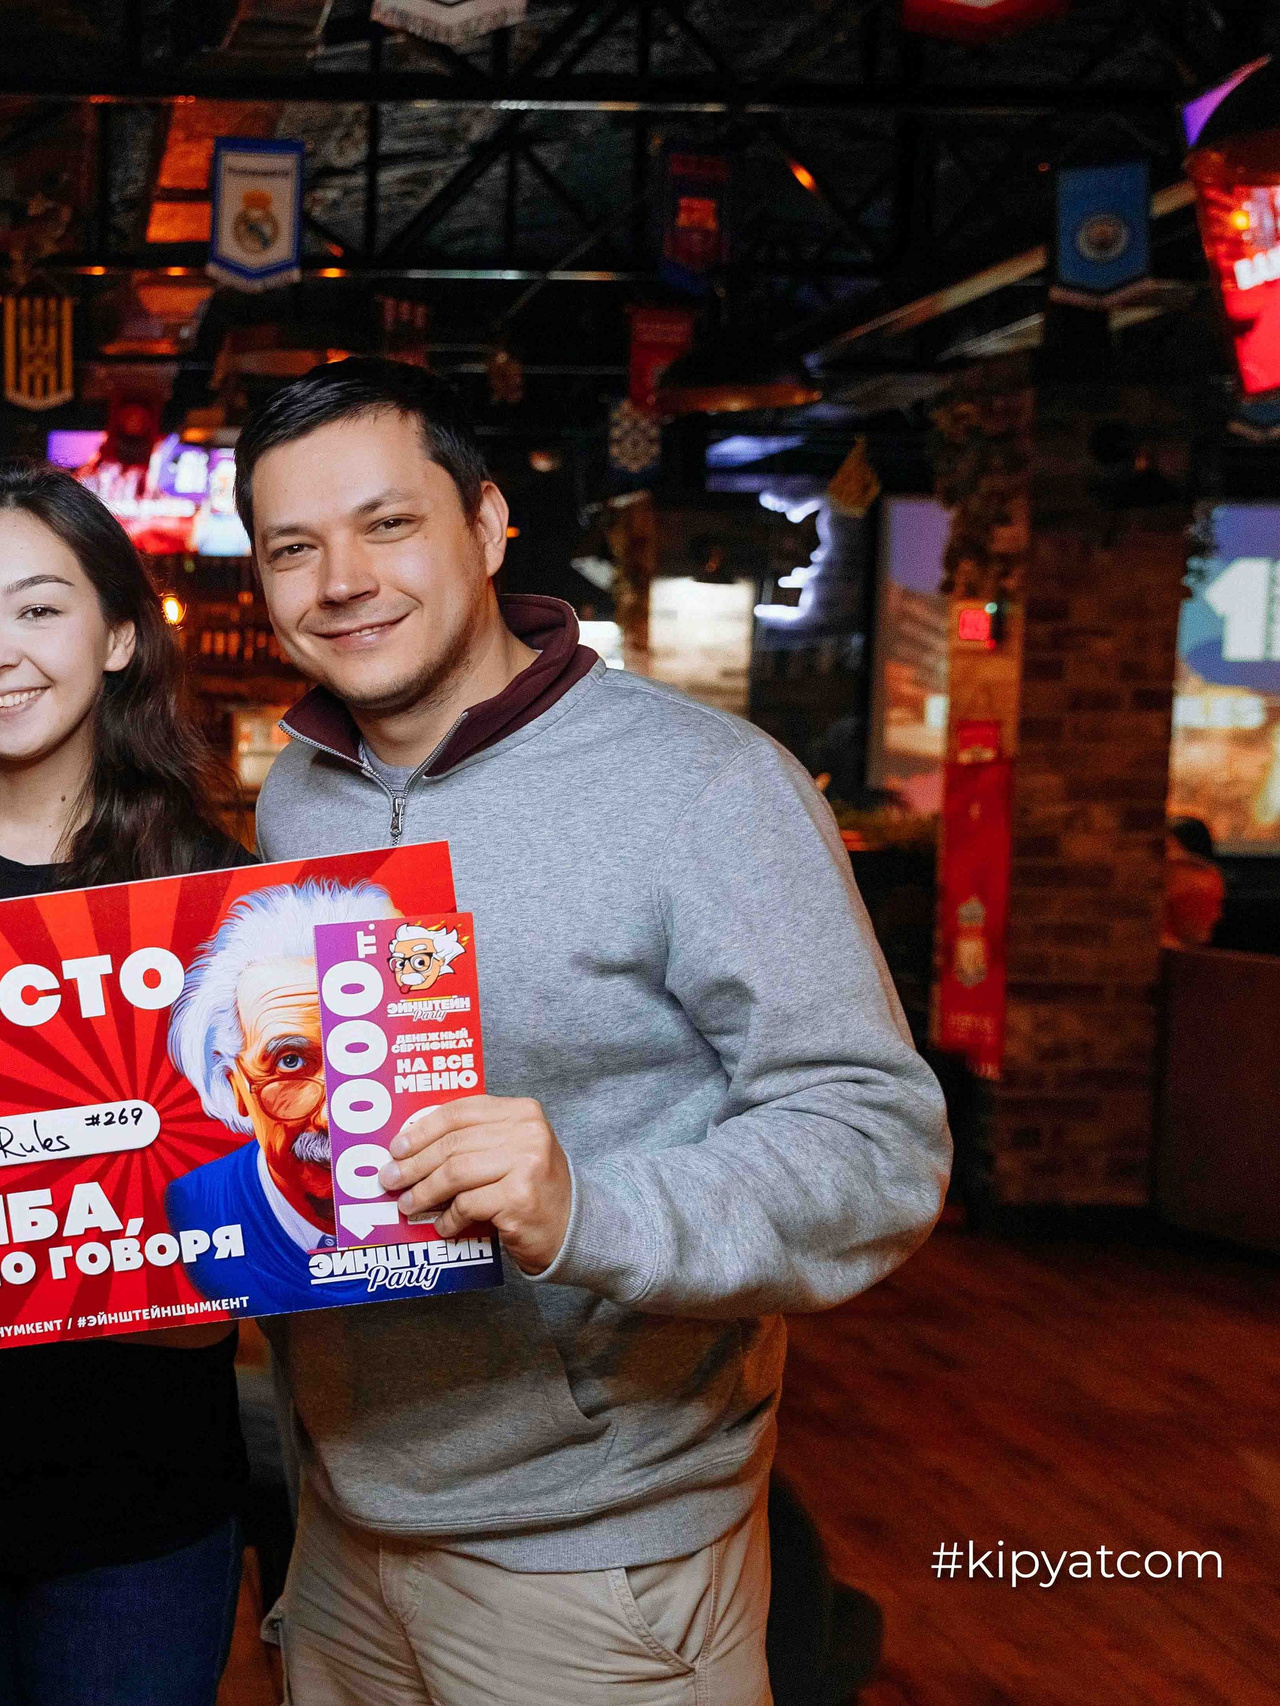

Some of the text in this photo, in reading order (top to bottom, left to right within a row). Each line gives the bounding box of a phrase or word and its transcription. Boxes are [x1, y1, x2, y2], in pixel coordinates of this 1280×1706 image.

[412, 1008, 447, 1022] Party
[391, 1038, 474, 1054] СЕРТИФИКАТ
[395, 1027, 469, 1045] ДЕНЕЖНЫЙ
[396, 1054, 475, 1074] НА ВСЕ
[393, 1069, 479, 1094] МЕНЮ
[84, 1107, 144, 1127] #269
[48, 1224, 246, 1280] ГОВОРЯ
[367, 1260, 442, 1292] Party
[77, 1296, 250, 1329] #ЭЙНШТЕЙНШЫМКЕНТ
